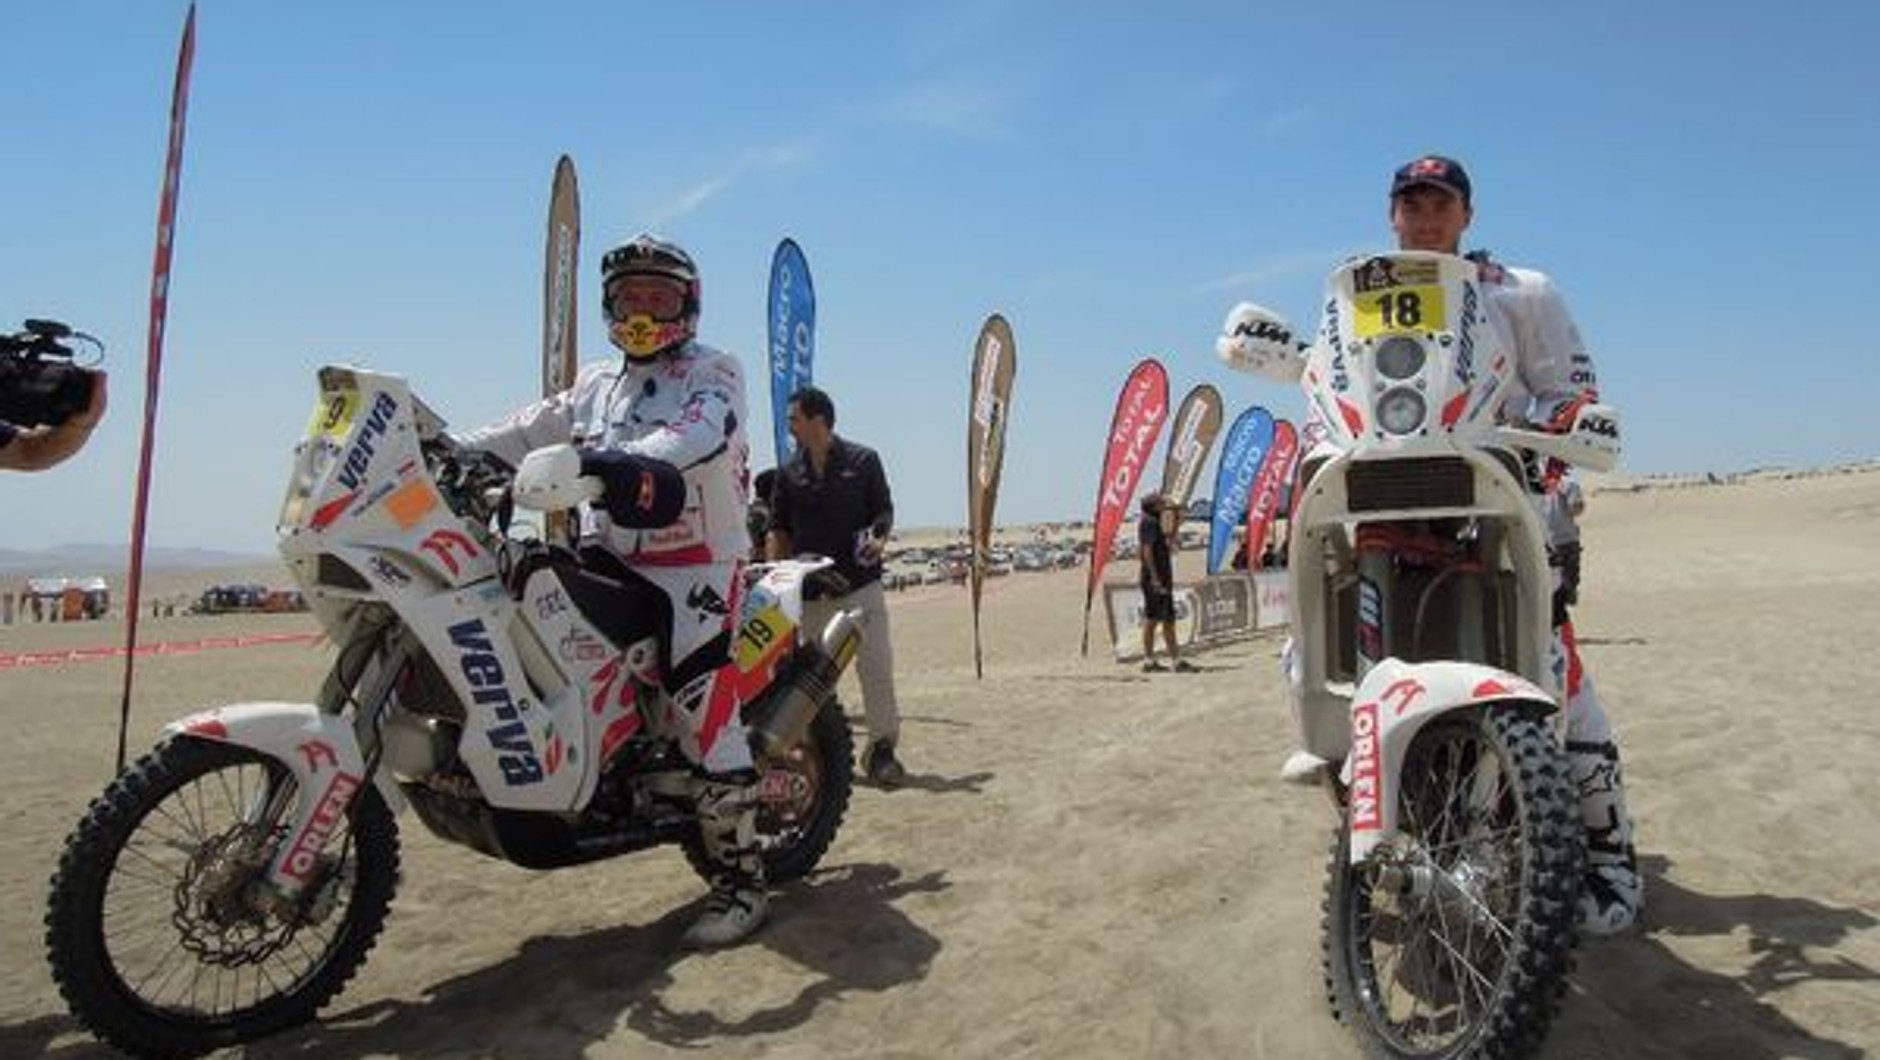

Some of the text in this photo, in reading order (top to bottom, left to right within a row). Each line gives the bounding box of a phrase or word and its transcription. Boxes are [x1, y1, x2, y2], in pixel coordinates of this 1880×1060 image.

[1233, 320, 1291, 346] KTM
[1375, 291, 1421, 328] 18
[334, 389, 399, 490] verva
[1101, 401, 1163, 507] TOTAL
[1250, 443, 1293, 521] TOTAL
[1217, 445, 1262, 524] Macro
[739, 616, 774, 652] 19
[447, 617, 544, 786] verva
[1352, 711, 1377, 826] ORLEN
[290, 777, 359, 875] ORLEN
